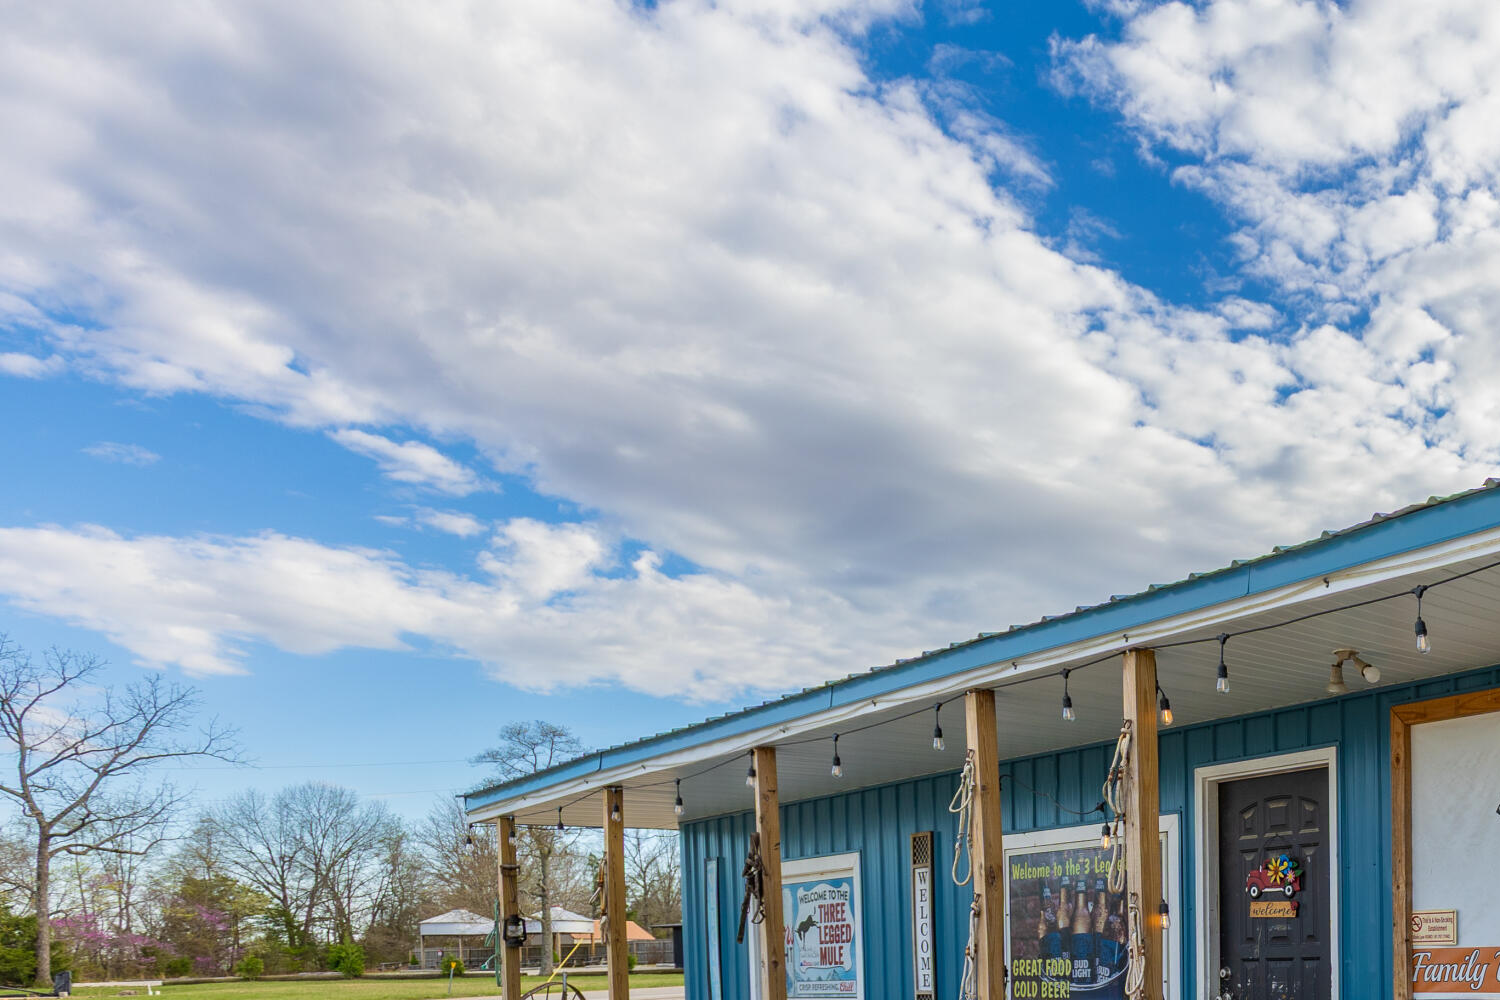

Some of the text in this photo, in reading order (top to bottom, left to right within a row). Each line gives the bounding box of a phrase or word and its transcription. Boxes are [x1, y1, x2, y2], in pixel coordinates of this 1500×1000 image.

[1012, 855, 1128, 880] Welcome to the 3 Lege
[799, 890, 848, 905] WELCOME TO THE
[818, 902, 846, 923] THREE
[1252, 903, 1292, 916] welcome
[818, 923, 852, 945] LEGGED
[918, 871, 930, 988] WELCOME
[820, 946, 844, 966] MULE
[1073, 959, 1089, 969] BUD
[1012, 959, 1072, 977] GREAT FOOD
[1072, 969, 1091, 978] LIGHT
[1412, 949, 1490, 990] Family
[1014, 980, 1070, 999] COLD BEER!
